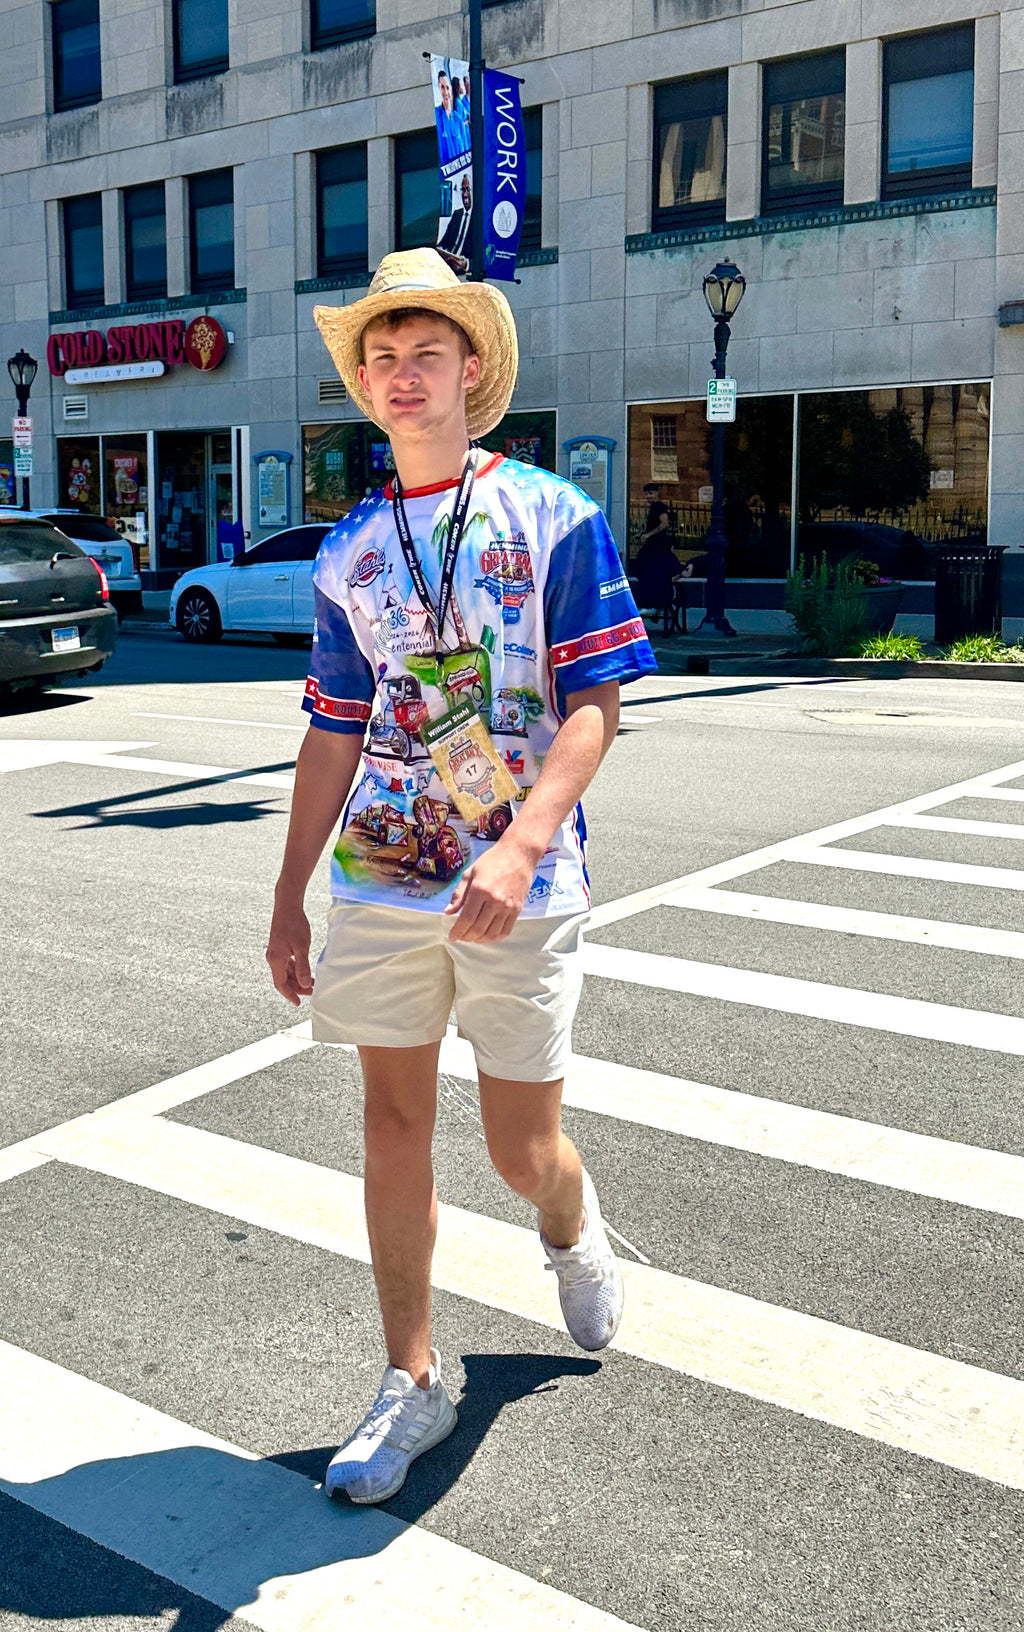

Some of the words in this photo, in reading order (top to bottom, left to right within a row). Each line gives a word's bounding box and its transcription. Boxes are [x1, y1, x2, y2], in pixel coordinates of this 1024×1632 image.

[494, 87, 518, 194] WORK
[47, 330, 104, 376] COLD
[107, 320, 184, 365] STONE
[710, 382, 716, 393] 2
[450, 523, 460, 551] COKER
[480, 551, 514, 575] GREAT
[412, 569, 425, 595] COKER
[391, 636, 433, 653] entennial
[605, 632, 620, 646] 66
[427, 720, 452, 738] William
[452, 707, 470, 723] Stahl
[438, 729, 458, 745] SUPPORT
[465, 764, 477, 776] 17
[527, 881, 564, 904] PEAK
